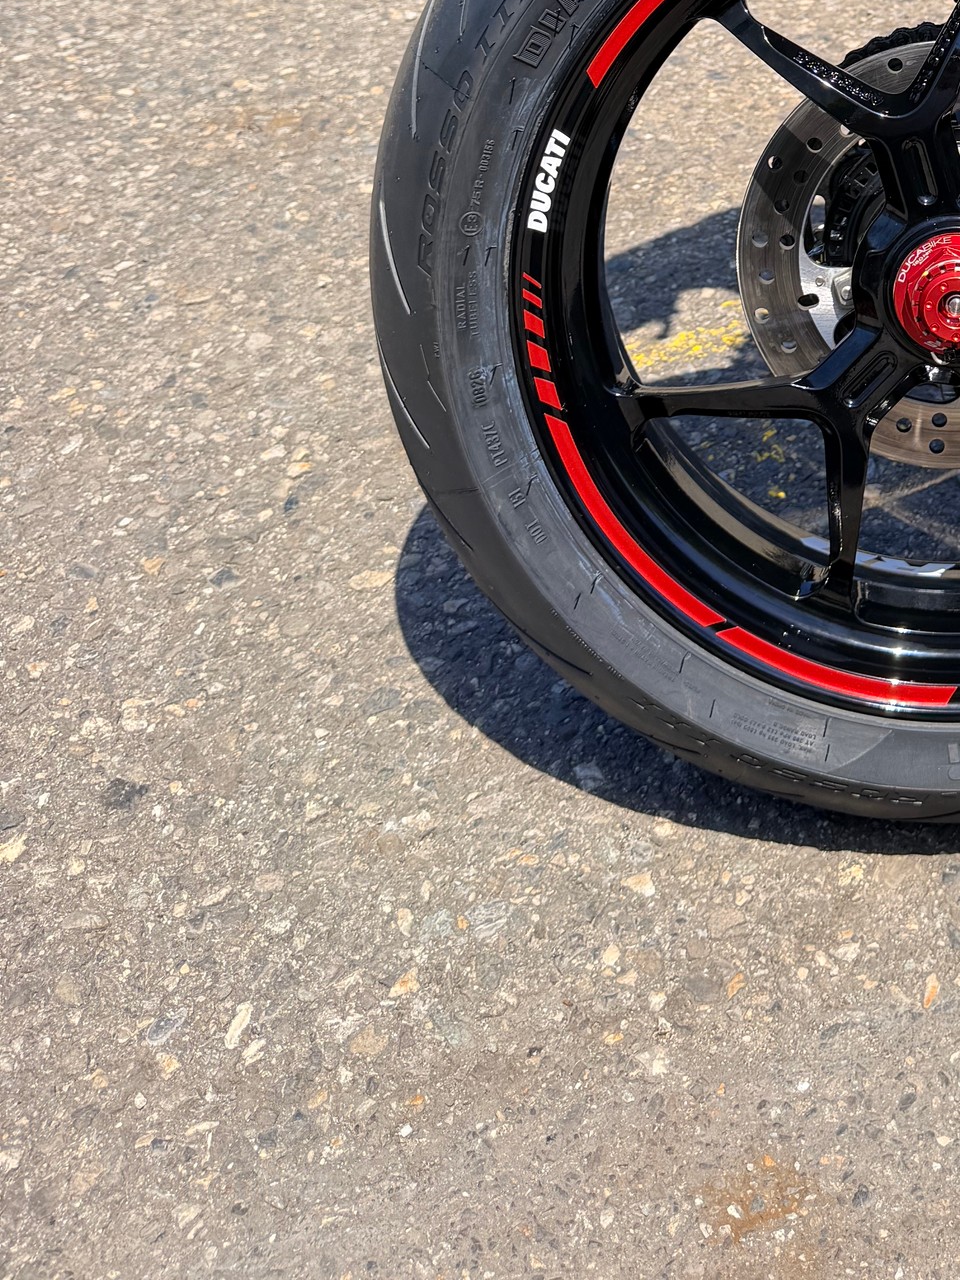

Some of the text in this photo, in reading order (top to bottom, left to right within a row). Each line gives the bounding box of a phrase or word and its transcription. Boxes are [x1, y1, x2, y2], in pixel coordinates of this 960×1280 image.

[418, 70, 475, 277] ROSSO
[527, 129, 571, 233] DUCATI
[897, 236, 952, 283] DUCABIKE
[456, 282, 467, 330] RADIAL
[469, 270, 478, 339] TUBELESS
[523, 517, 549, 546] DOT
